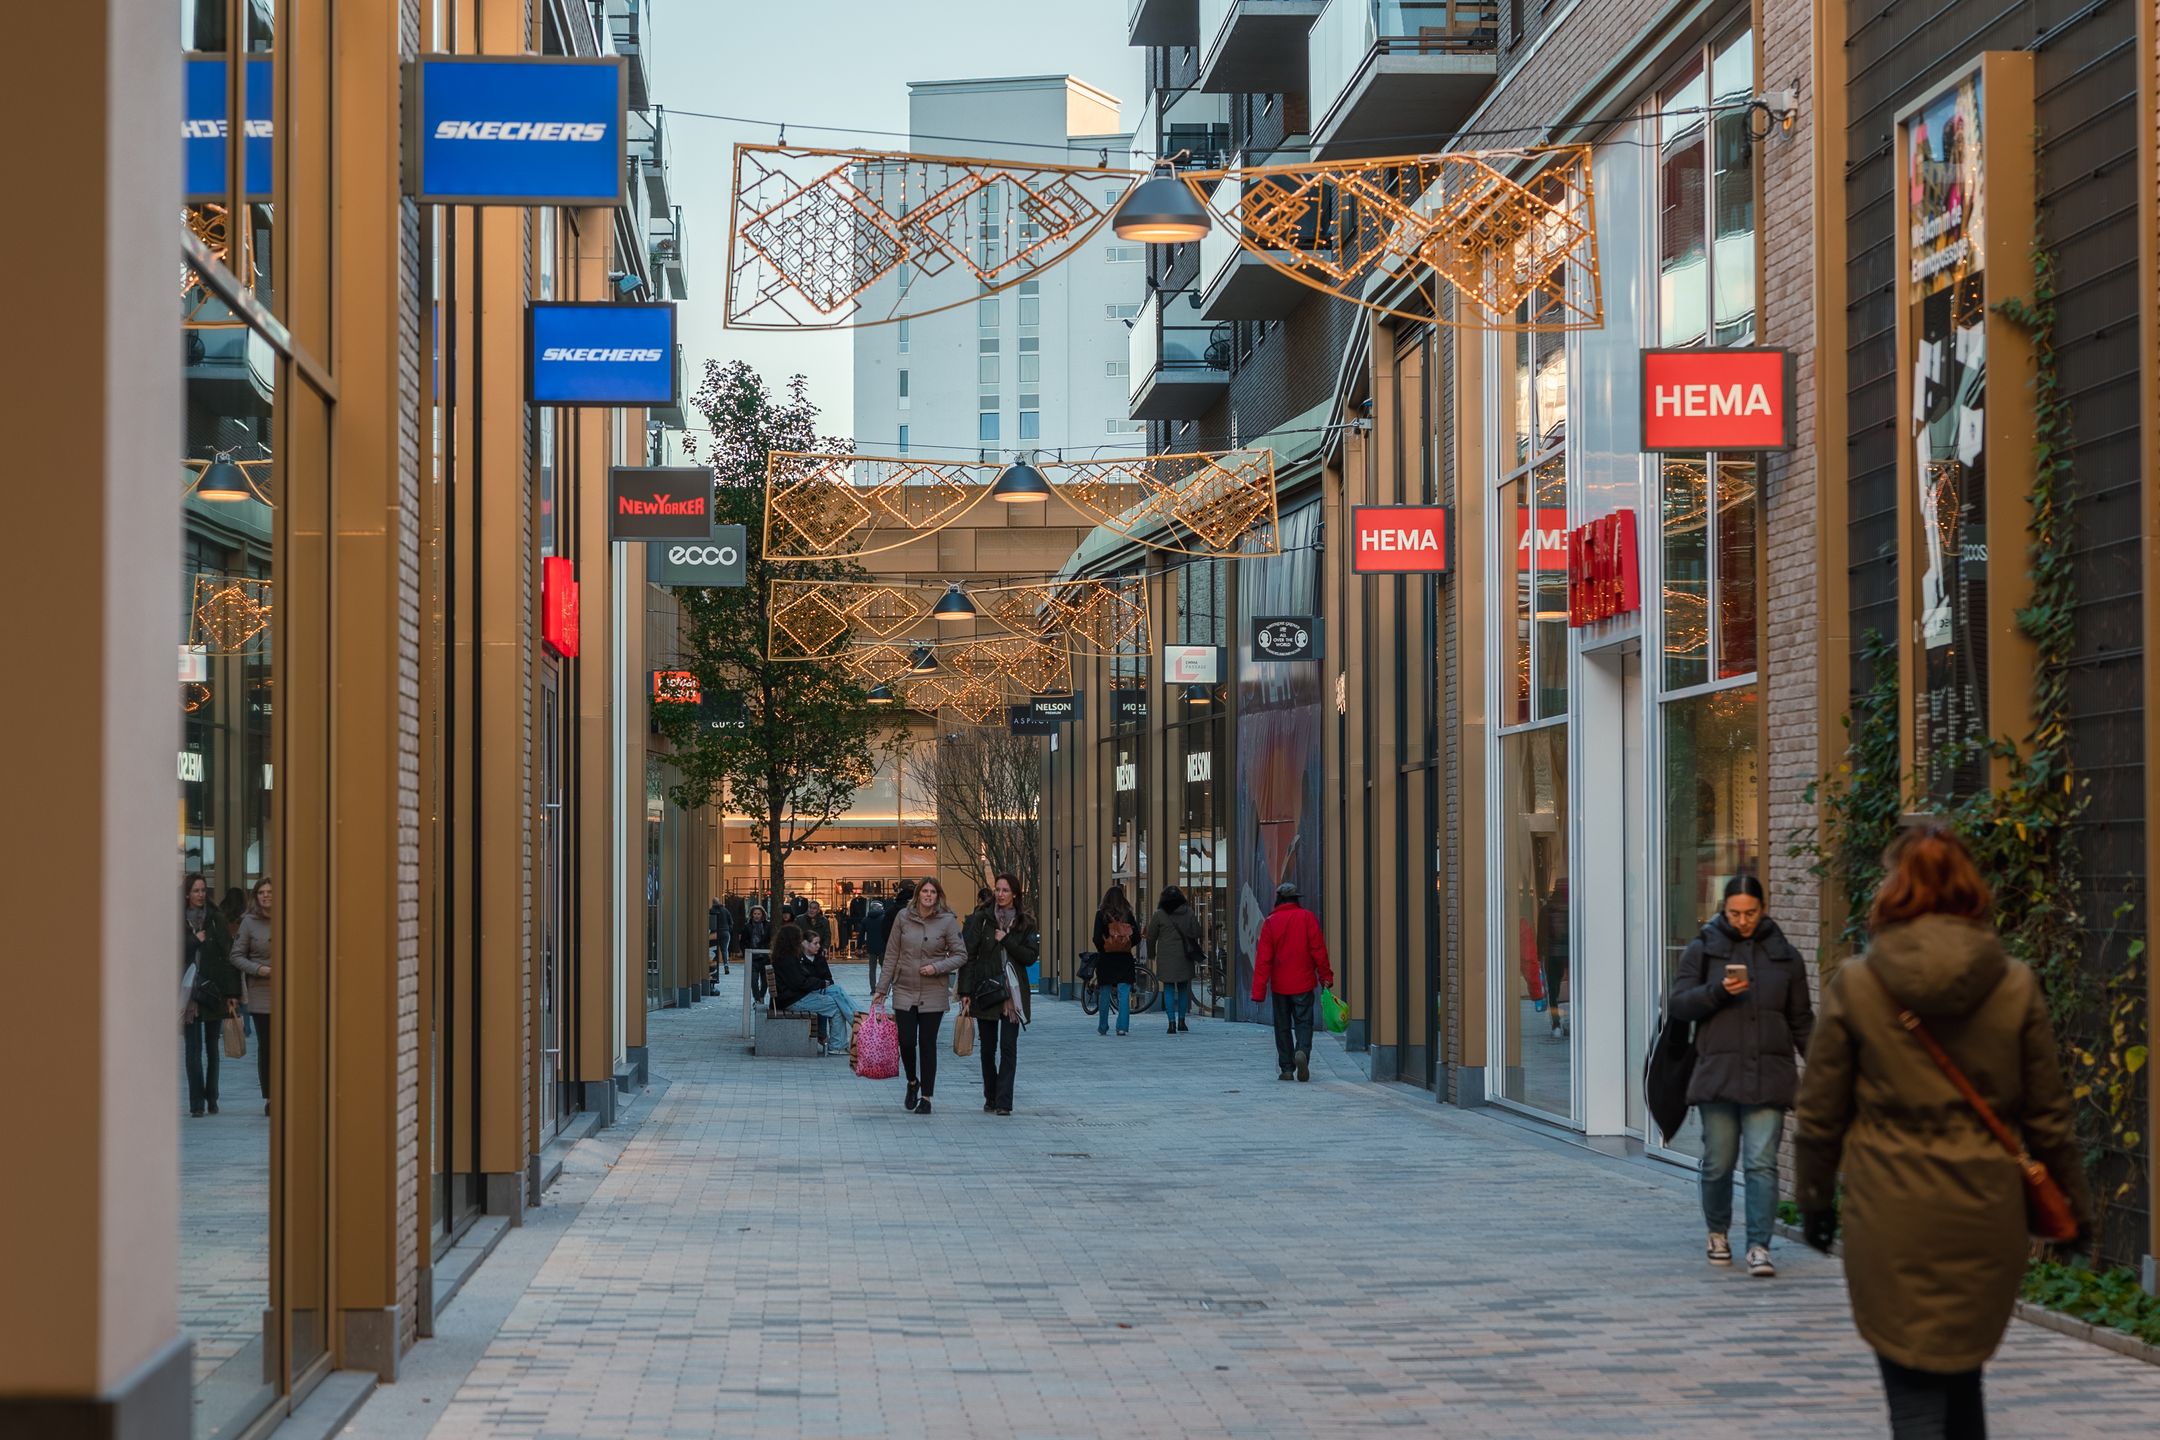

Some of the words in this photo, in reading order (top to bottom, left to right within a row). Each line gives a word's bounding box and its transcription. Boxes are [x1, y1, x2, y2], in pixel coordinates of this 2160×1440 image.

[434, 120, 607, 142] SKECHERS
[542, 348, 663, 362] SKECHERS
[1655, 383, 1772, 417] HEMA
[1361, 529, 1439, 551] HEMA
[668, 545, 738, 566] ecco
[1035, 703, 1072, 711] NELSON
[1116, 762, 1136, 792] NELSON
[1187, 751, 1211, 783] NELSON
